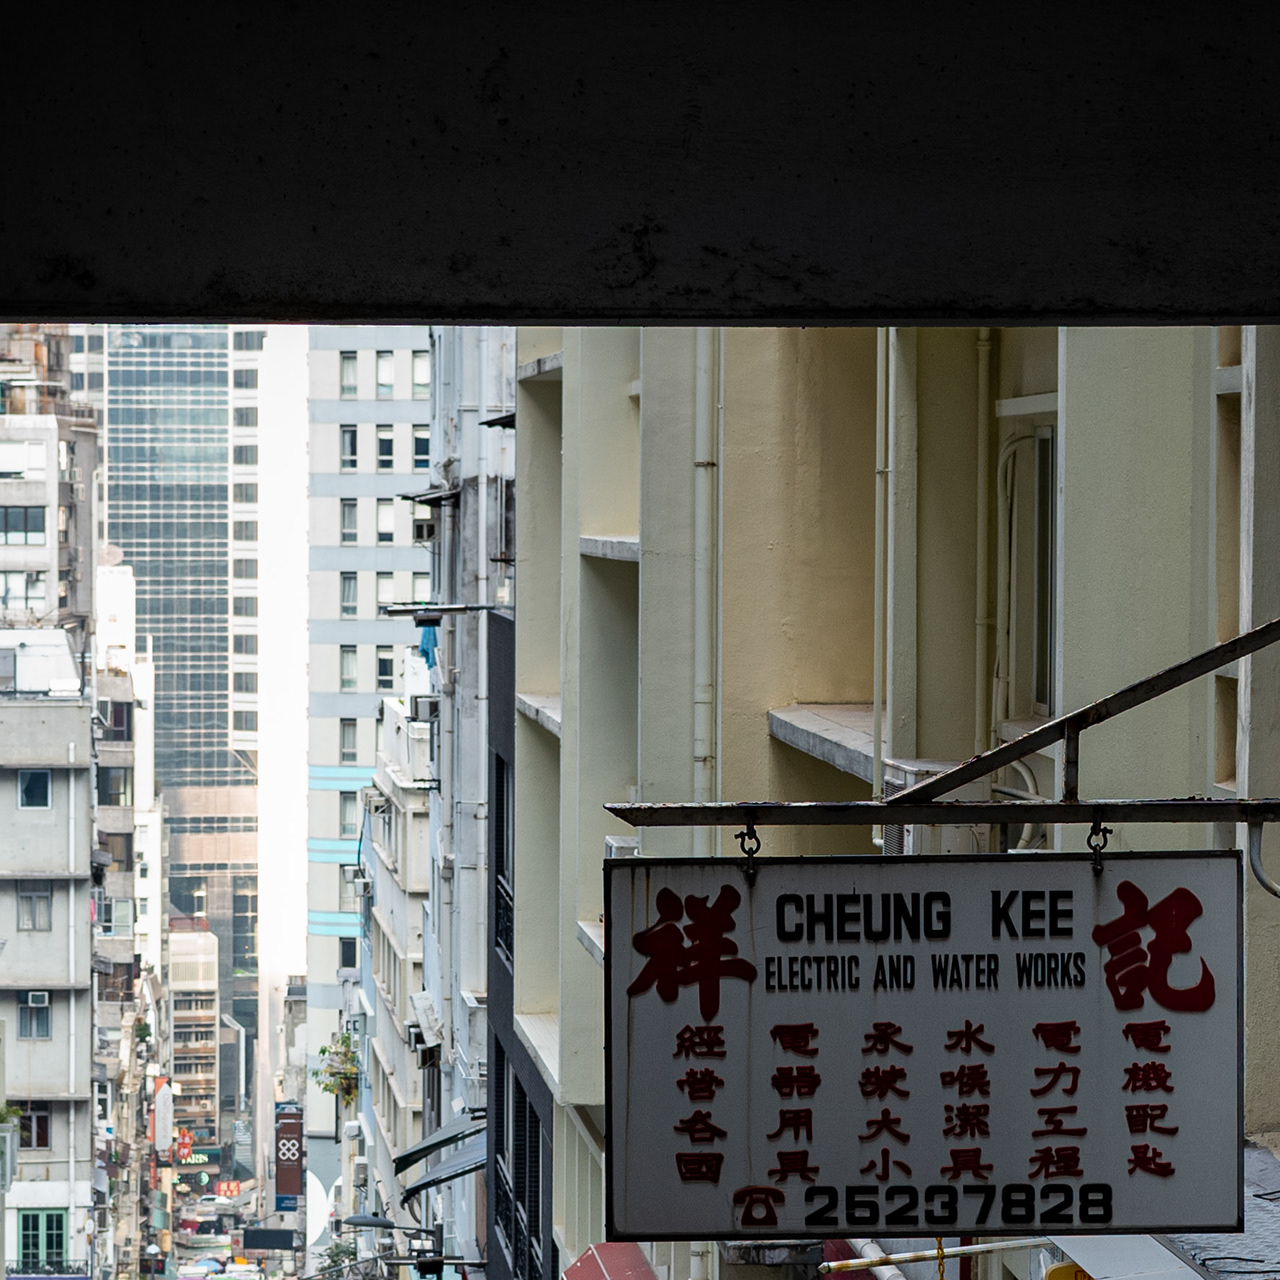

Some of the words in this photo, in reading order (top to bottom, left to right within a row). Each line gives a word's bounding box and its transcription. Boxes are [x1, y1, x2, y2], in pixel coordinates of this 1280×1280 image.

[627, 882, 756, 1020] 祥
[765, 955, 860, 992] ELECTRIC
[873, 954, 915, 990] AND
[931, 953, 999, 990] WATER
[1016, 952, 1085, 989] WORKS
[776, 892, 951, 942] CHEUNG
[991, 890, 1073, 938] KEE
[1092, 881, 1216, 1012] 記
[767, 1022, 821, 1182] 電器用具
[1029, 1020, 1087, 1179] 電力工程
[1122, 1020, 1178, 1178] 電機配匙
[805, 1183, 1114, 1227] 25237828
